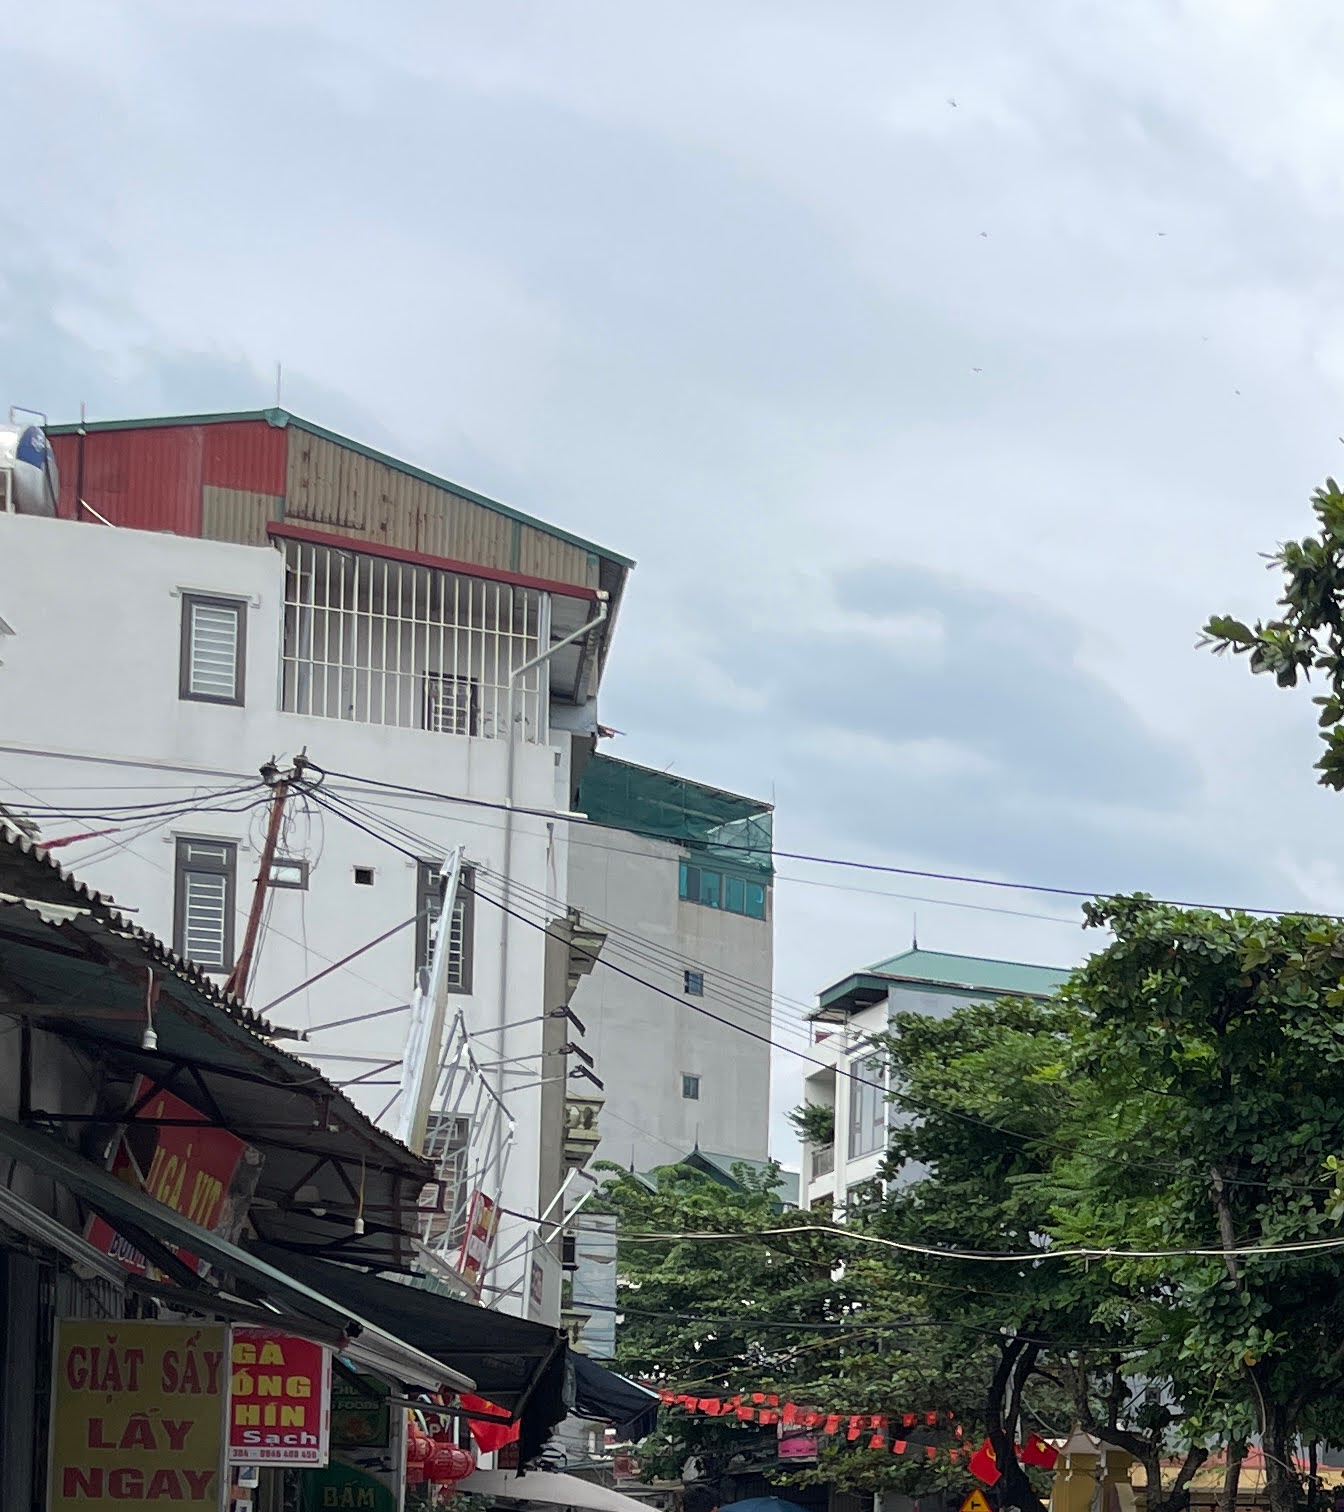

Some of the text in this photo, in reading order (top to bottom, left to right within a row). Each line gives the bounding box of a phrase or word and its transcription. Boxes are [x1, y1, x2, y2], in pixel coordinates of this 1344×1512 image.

[67, 1330, 223, 1404] GIẶT SẤY
[88, 1407, 194, 1450] LẤY
[235, 1402, 305, 1427] HÍN
[243, 1430, 317, 1447] Sạch
[63, 1467, 216, 1500] NGAY
